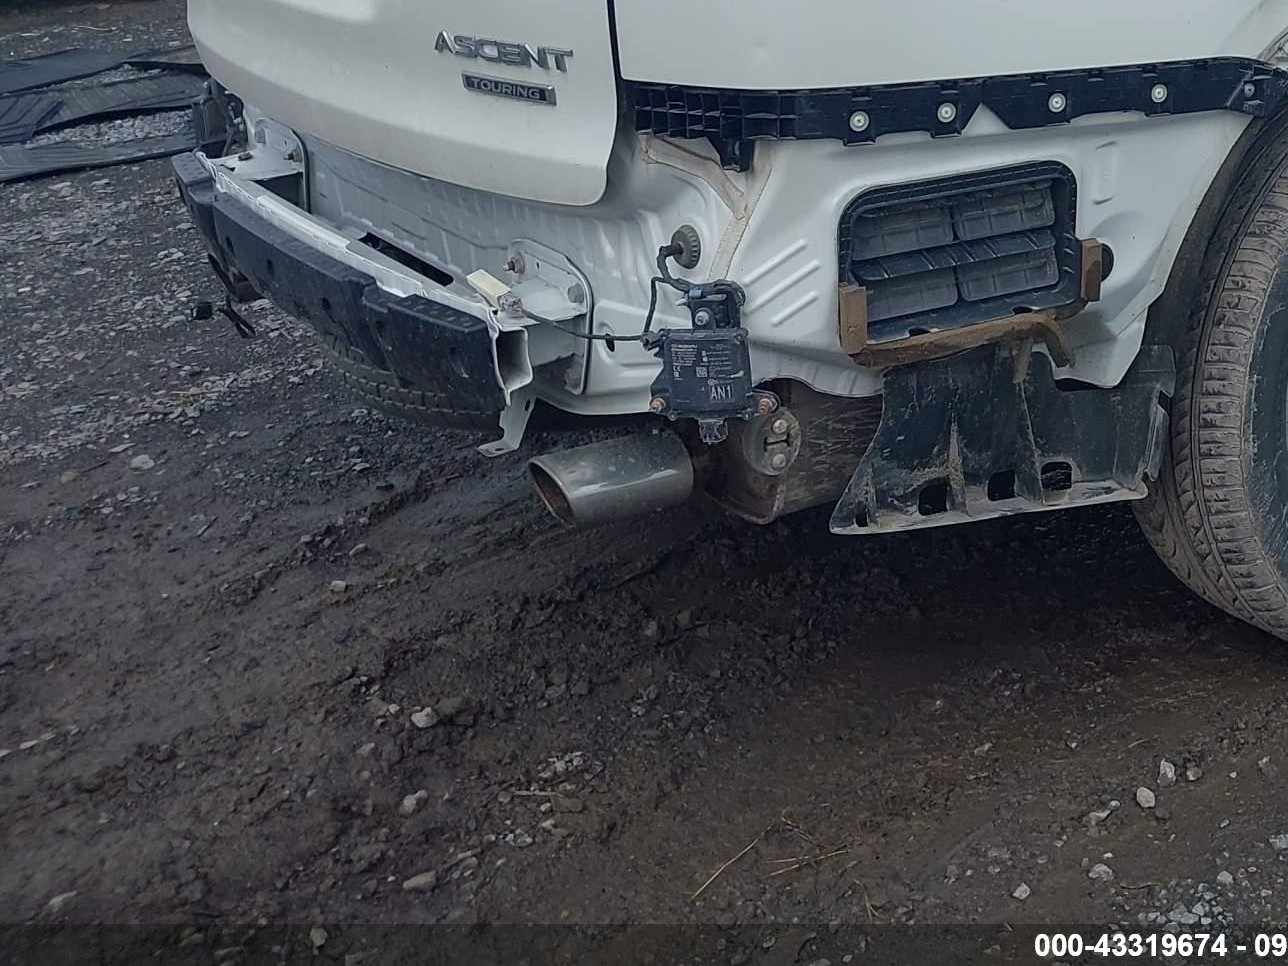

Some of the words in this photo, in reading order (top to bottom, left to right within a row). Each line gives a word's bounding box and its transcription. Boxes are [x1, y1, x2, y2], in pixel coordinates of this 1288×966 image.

[434, 30, 574, 72] ASCENT
[470, 77, 540, 100] TOURING
[710, 385, 732, 400] AN1
